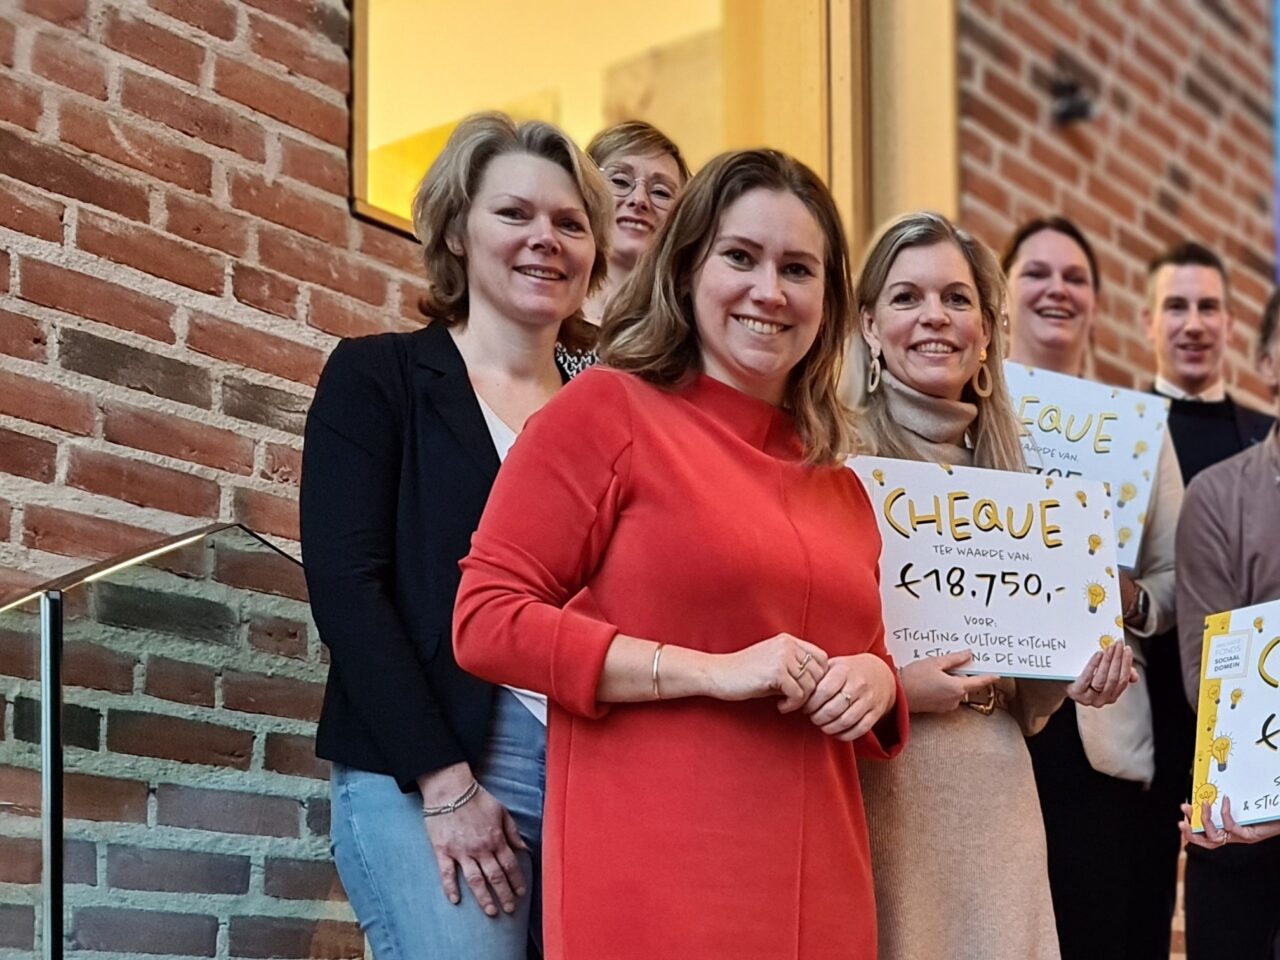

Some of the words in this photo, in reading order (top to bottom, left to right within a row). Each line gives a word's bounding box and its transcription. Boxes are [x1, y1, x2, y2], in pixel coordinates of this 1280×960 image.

[883, 487, 1063, 548] CHEQUE
[932, 544, 953, 555] TER
[956, 547, 1004, 560] WAARDE
[894, 562, 1066, 606] €18.750,-
[963, 615, 998, 628] VOOR:
[892, 629, 960, 643] STICHTING
[964, 633, 1015, 648] CULTURE
[1018, 638, 1067, 651] KITCHEN
[995, 652, 1014, 666] DE
[1018, 656, 1053, 668] WELLE
[1213, 661, 1241, 672] DOMEIN
[1214, 654, 1241, 665] SOCIAAL
[1243, 801, 1250, 812] &
